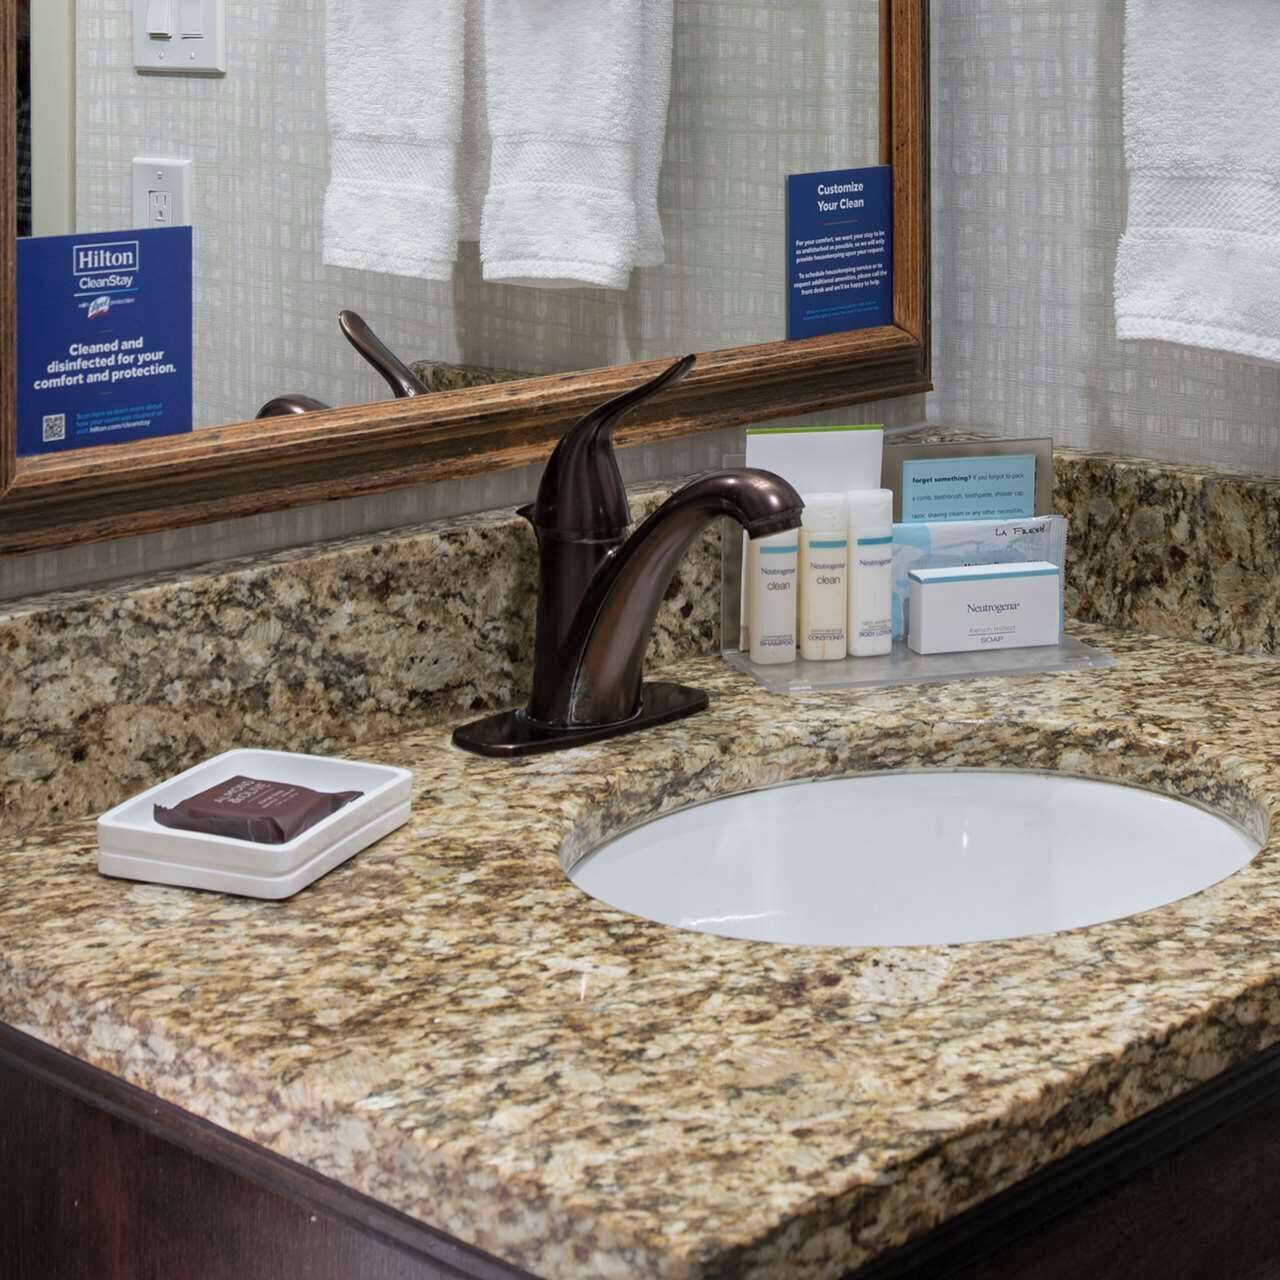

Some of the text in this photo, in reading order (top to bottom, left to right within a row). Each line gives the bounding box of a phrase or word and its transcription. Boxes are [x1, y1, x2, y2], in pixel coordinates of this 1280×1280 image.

[817, 181, 864, 196] Customize
[817, 198, 864, 212] Your Clean
[79, 250, 133, 269] Hilton
[79, 275, 133, 289] CleanStay
[69, 336, 144, 356] Cleaned and
[47, 350, 164, 373] disinfected for your
[33, 363, 177, 390] comfort and protection.
[934, 474, 972, 483] something?
[767, 581, 790, 591] clean
[816, 576, 840, 584] clean
